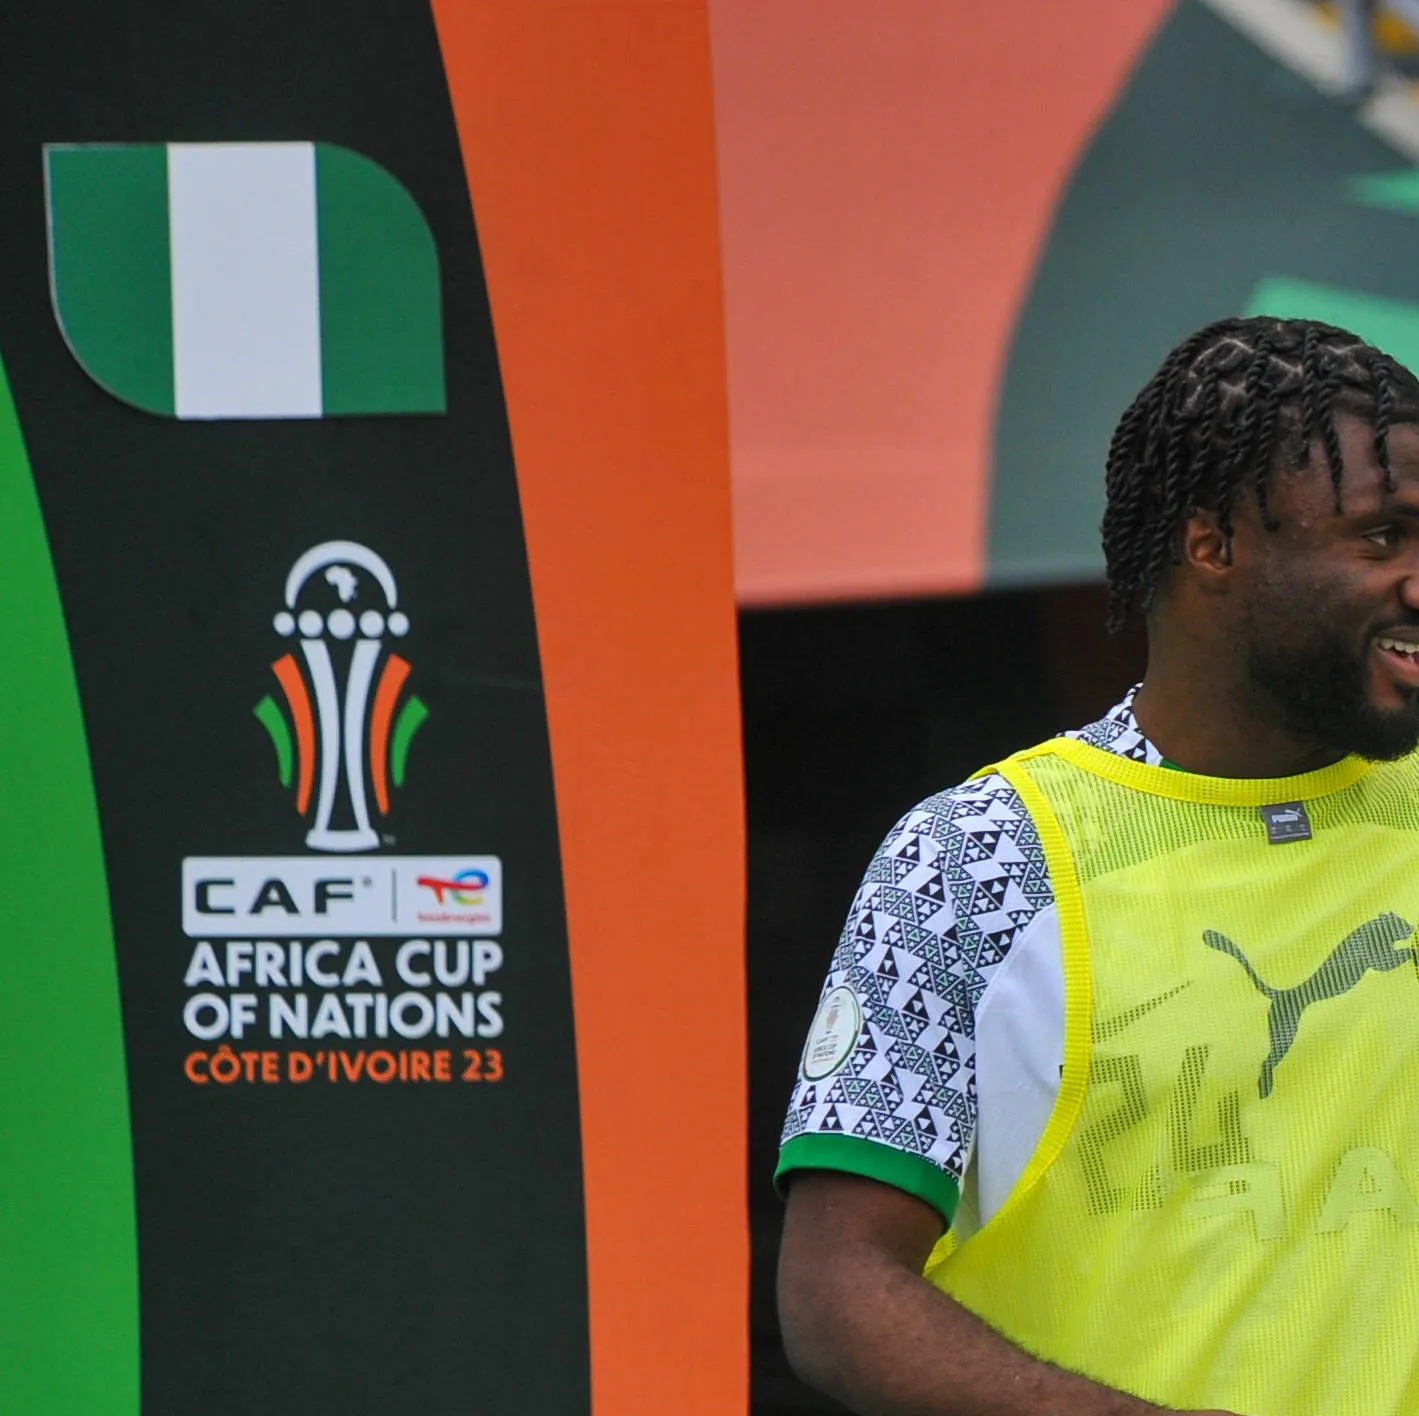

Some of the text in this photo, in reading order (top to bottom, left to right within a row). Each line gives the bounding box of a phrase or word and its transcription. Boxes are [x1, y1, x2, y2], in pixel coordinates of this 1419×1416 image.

[193, 877, 354, 916] CAF
[183, 938, 504, 988] AFRICA CUP
[182, 991, 504, 1040] OF NATIONS
[183, 1044, 504, 1084] CÔTE D'IVOIRE 23
[1058, 1043, 1254, 1217] 24
